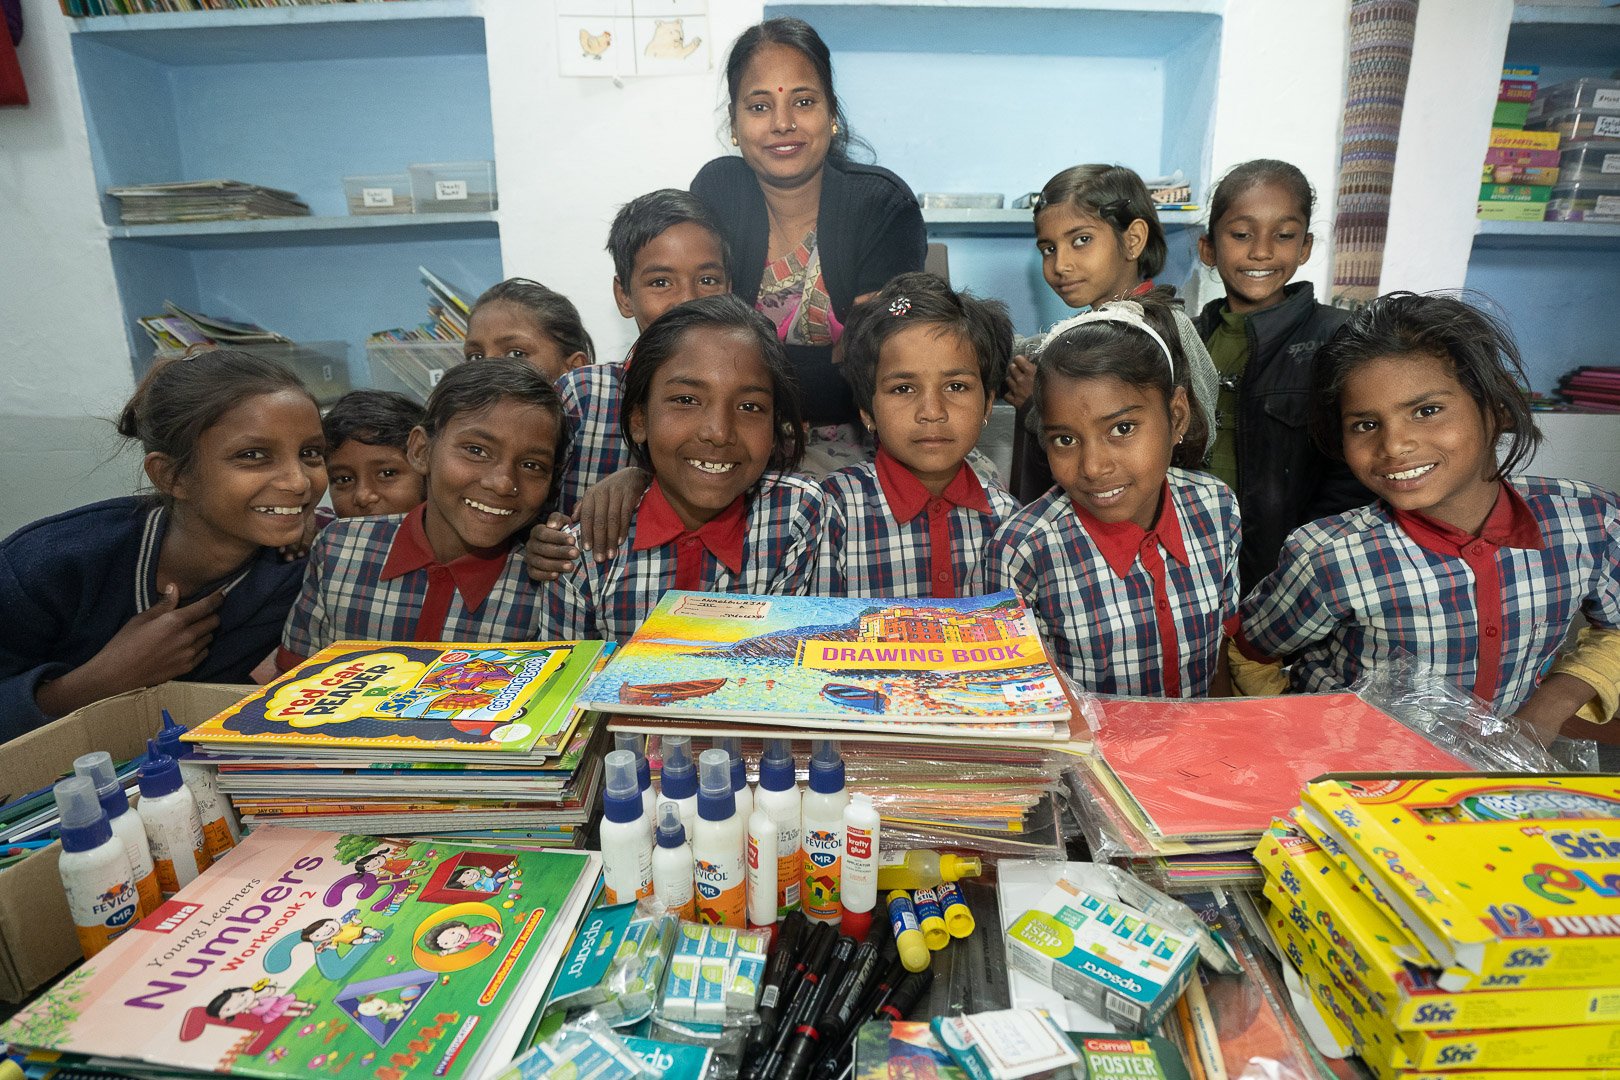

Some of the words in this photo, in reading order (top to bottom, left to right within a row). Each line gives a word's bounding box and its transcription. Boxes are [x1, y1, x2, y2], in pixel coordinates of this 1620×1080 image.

[822, 647, 944, 663] DRAWING
[953, 644, 1025, 663] BOOK
[278, 688, 329, 717] red
[327, 662, 365, 687] car
[304, 664, 396, 716] READER
[1334, 808, 1361, 828] Stic
[805, 836, 842, 850] FEVICOL
[848, 837, 869, 849] krafty
[851, 846, 866, 855] glue
[814, 855, 832, 864] MR
[700, 886, 716, 896] MR
[1280, 869, 1302, 896] Stic
[917, 893, 935, 901] stik
[111, 908, 134, 925] MR
[147, 928, 206, 969] Young
[200, 877, 261, 926] Learners
[1487, 904, 1544, 936] 12
[124, 856, 324, 1010] Numbers
[220, 901, 306, 973] Workbook
[299, 890, 318, 900] 2
[1020, 930, 1045, 947] non
[1023, 922, 1063, 948] dust
[513, 940, 525, 958] Also
[568, 919, 603, 976] apsara
[1504, 947, 1550, 968] Stic
[1083, 960, 1142, 993] apsara
[1413, 1003, 1456, 1024] Stic
[1087, 1040, 1132, 1052] Camel
[1436, 1044, 1477, 1065] Stic
[1089, 1054, 1158, 1076] POSTER
